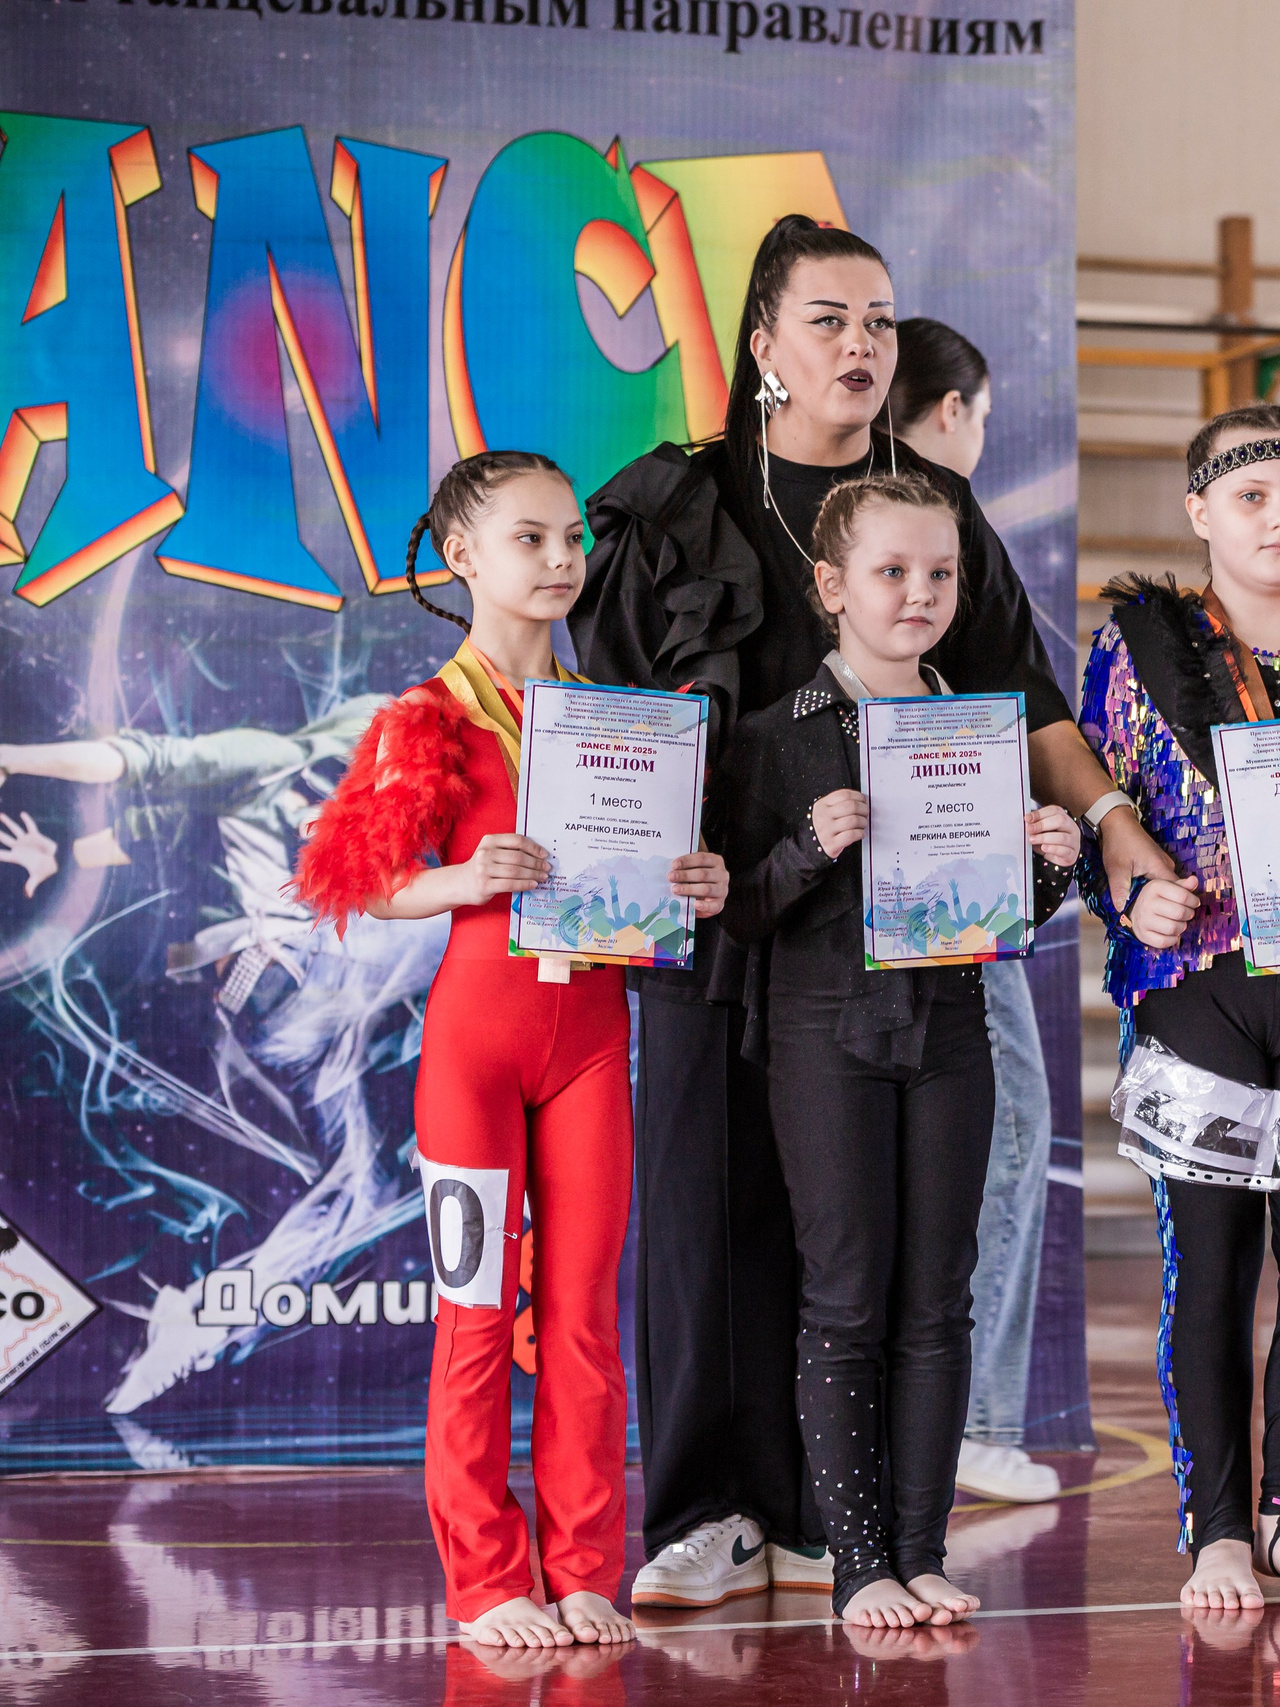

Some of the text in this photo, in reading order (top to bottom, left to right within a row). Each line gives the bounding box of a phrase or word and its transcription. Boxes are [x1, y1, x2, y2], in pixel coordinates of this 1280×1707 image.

[613, 0, 1045, 54] направлениям
[576, 741, 611, 750] «DANCE
[633, 746, 657, 754] 2025»
[576, 754, 654, 772] ДИПЛОМ
[910, 763, 981, 779] ДИПЛОМ
[594, 775, 636, 783] награждается
[590, 793, 642, 809] 1 место
[925, 802, 973, 813] 2 место
[565, 823, 661, 838] ХАРЧЕНКО ЕЛИЗАВЕТА
[910, 830, 990, 841] МЕРКИНА ВЕРОНИКА
[197, 1269, 439, 1327] Доми
